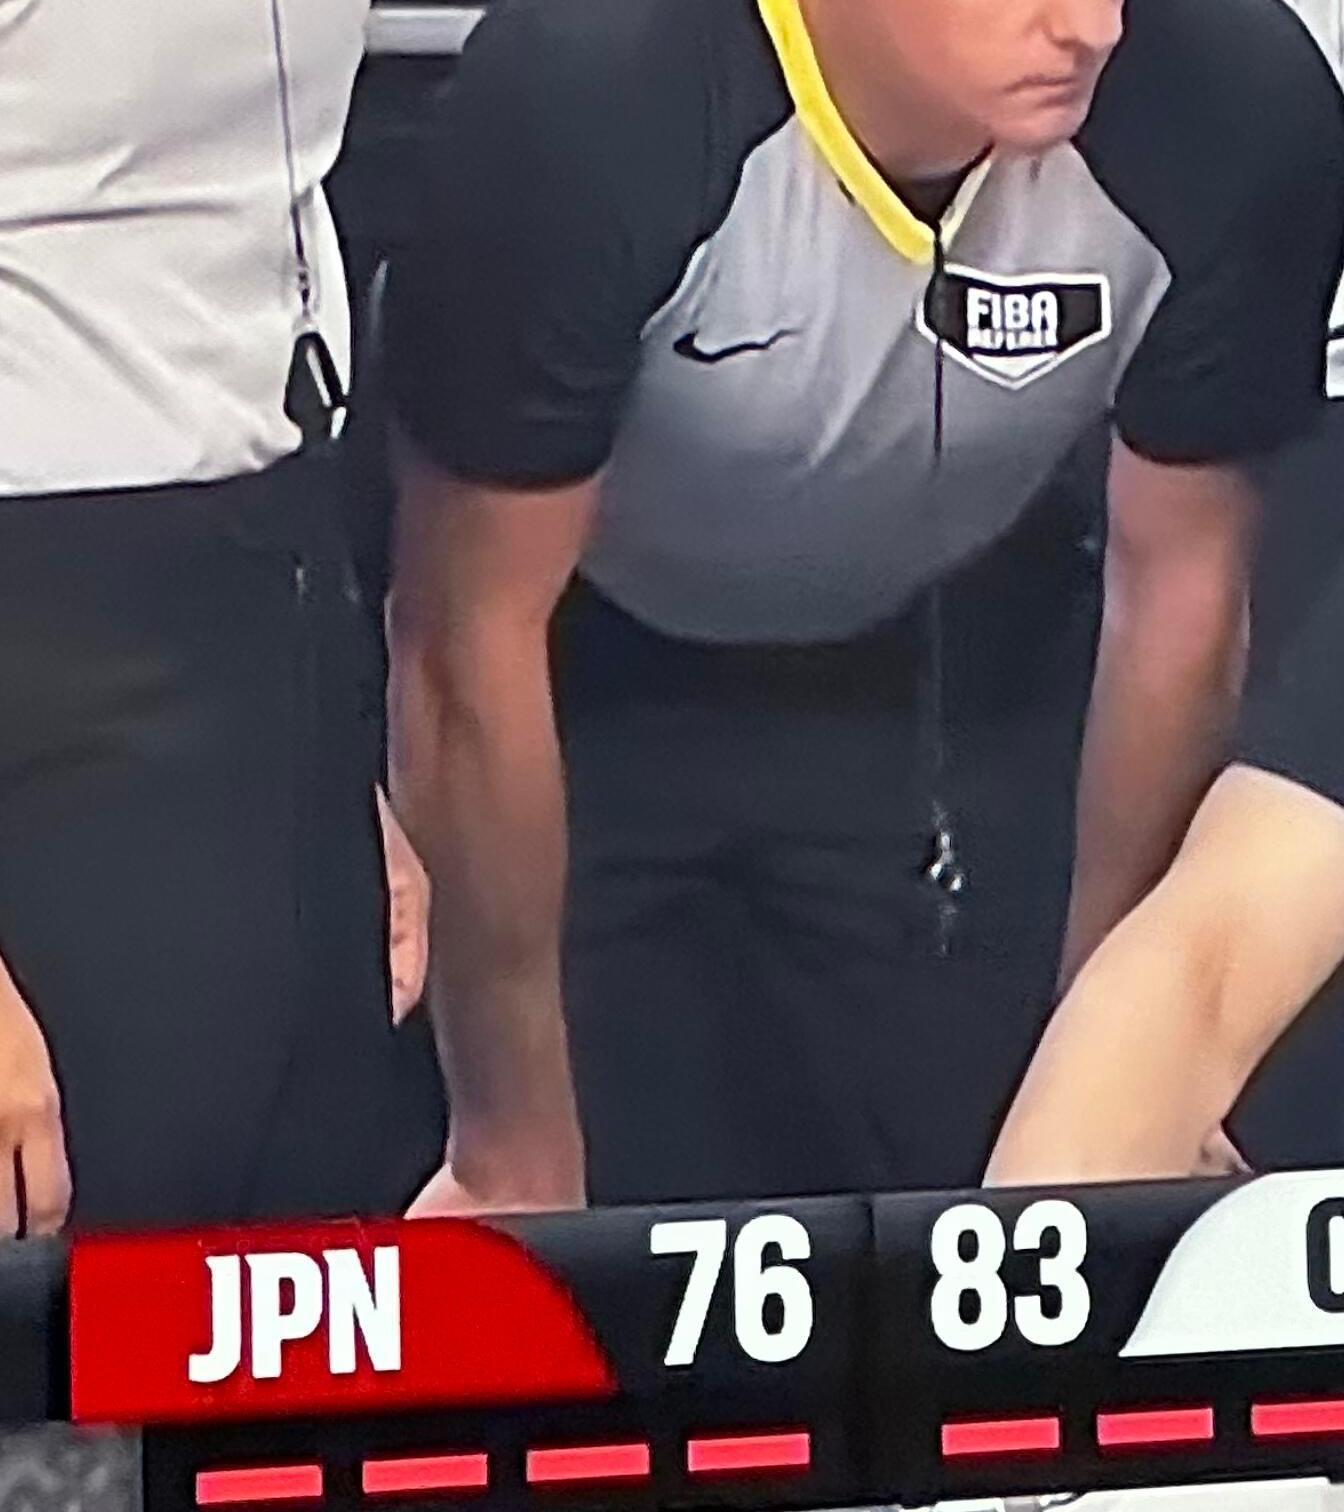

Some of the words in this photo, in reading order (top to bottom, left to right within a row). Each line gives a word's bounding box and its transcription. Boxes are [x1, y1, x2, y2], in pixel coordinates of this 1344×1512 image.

[966, 287, 1059, 331] FIBA
[187, 1244, 402, 1384] JPN
[649, 1213, 814, 1367] 76
[929, 1198, 1091, 1352] 83
